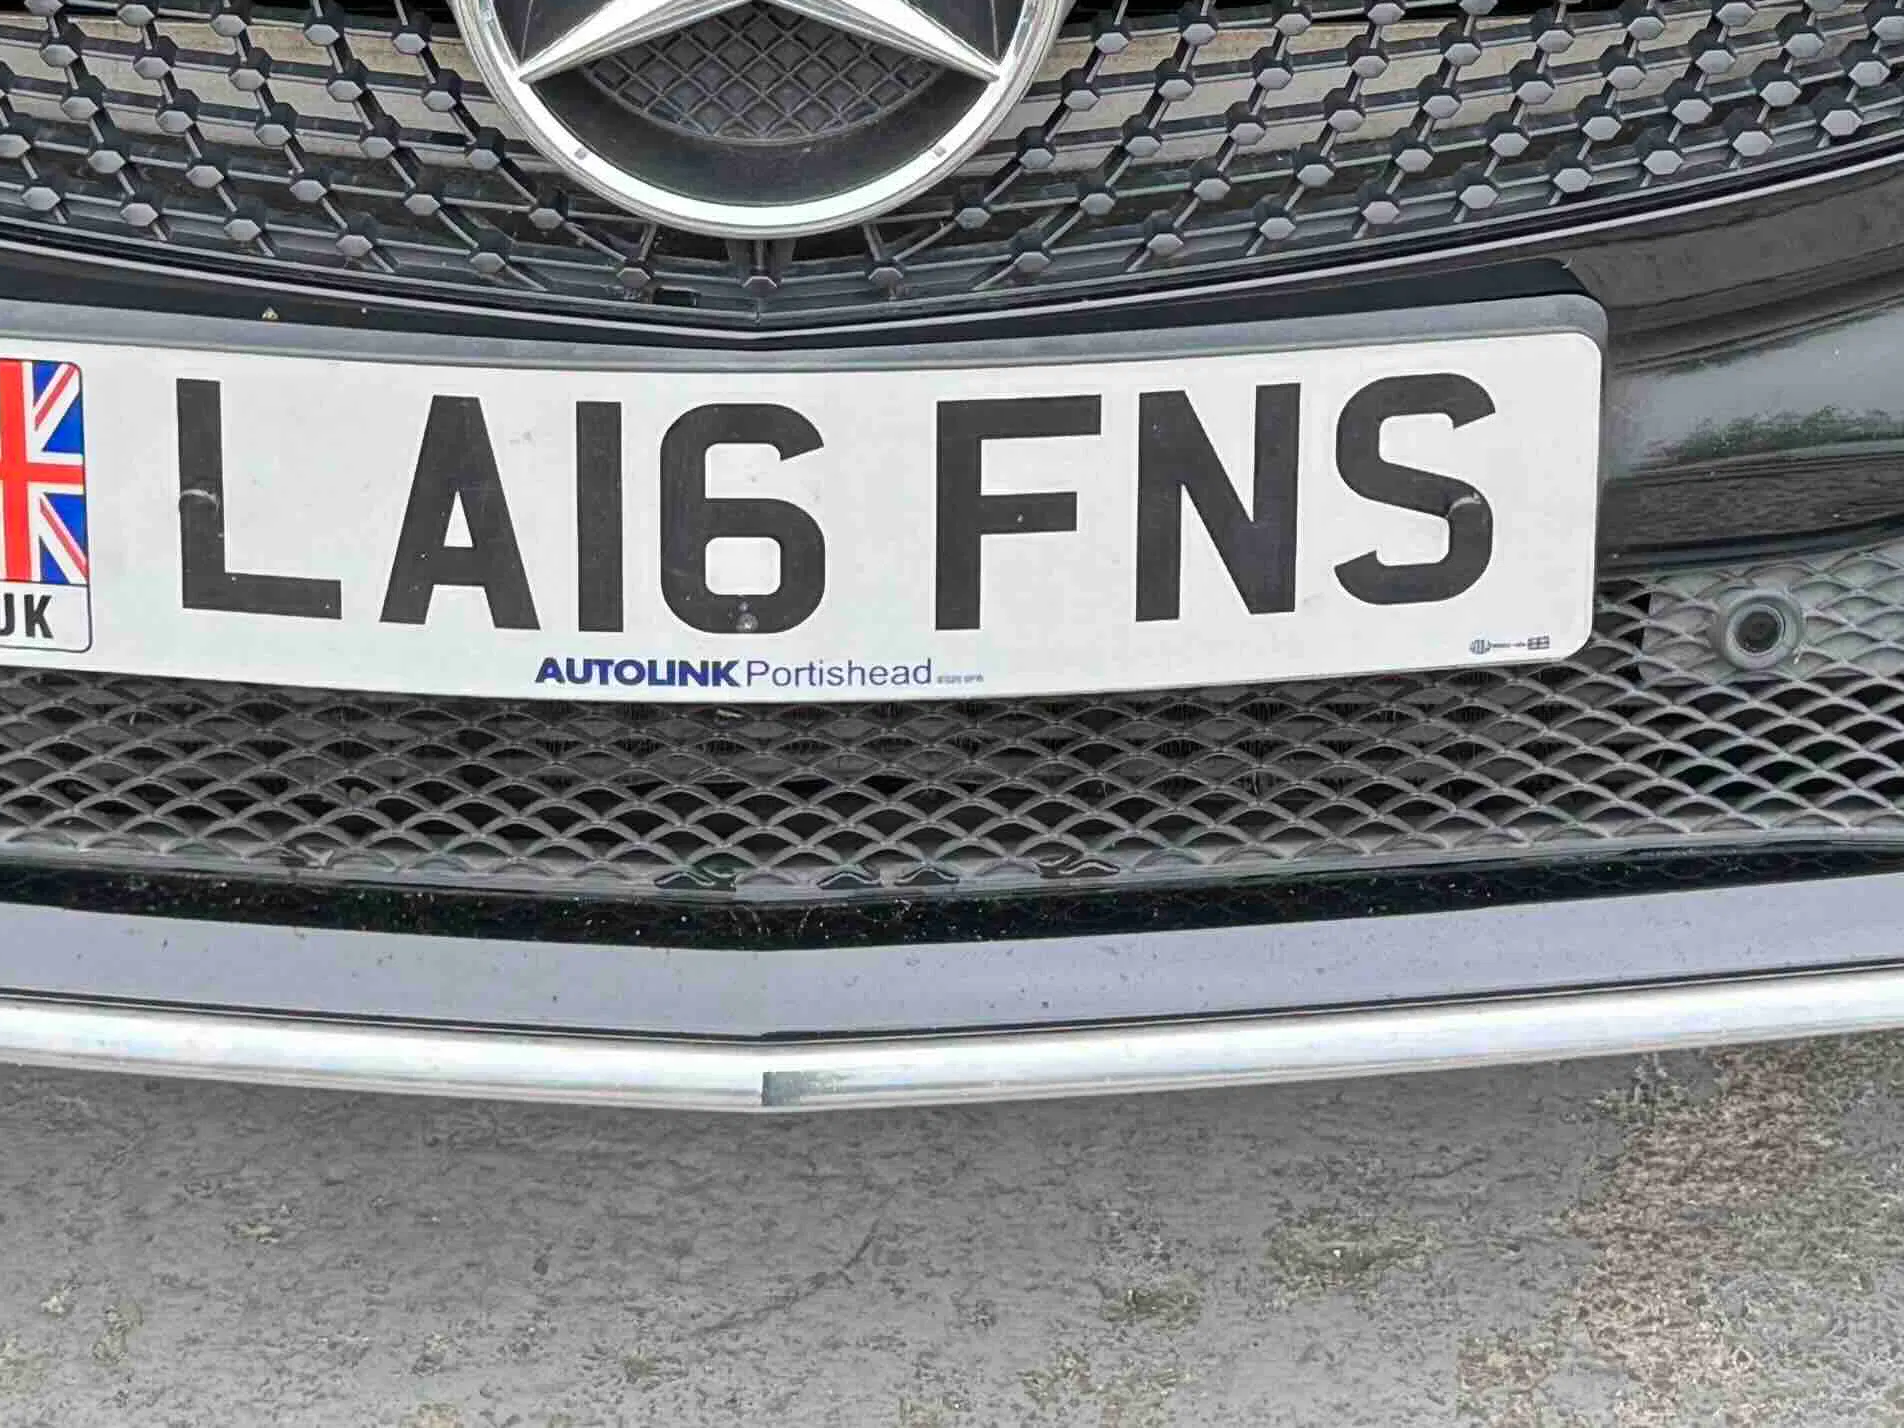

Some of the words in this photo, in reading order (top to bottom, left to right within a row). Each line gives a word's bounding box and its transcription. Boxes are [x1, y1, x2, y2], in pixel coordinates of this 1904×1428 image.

[176, 378, 827, 634] LA16
[935, 373, 1496, 631] FNS
[534, 656, 741, 687] AUTOLINK
[746, 657, 932, 687] Portishead
